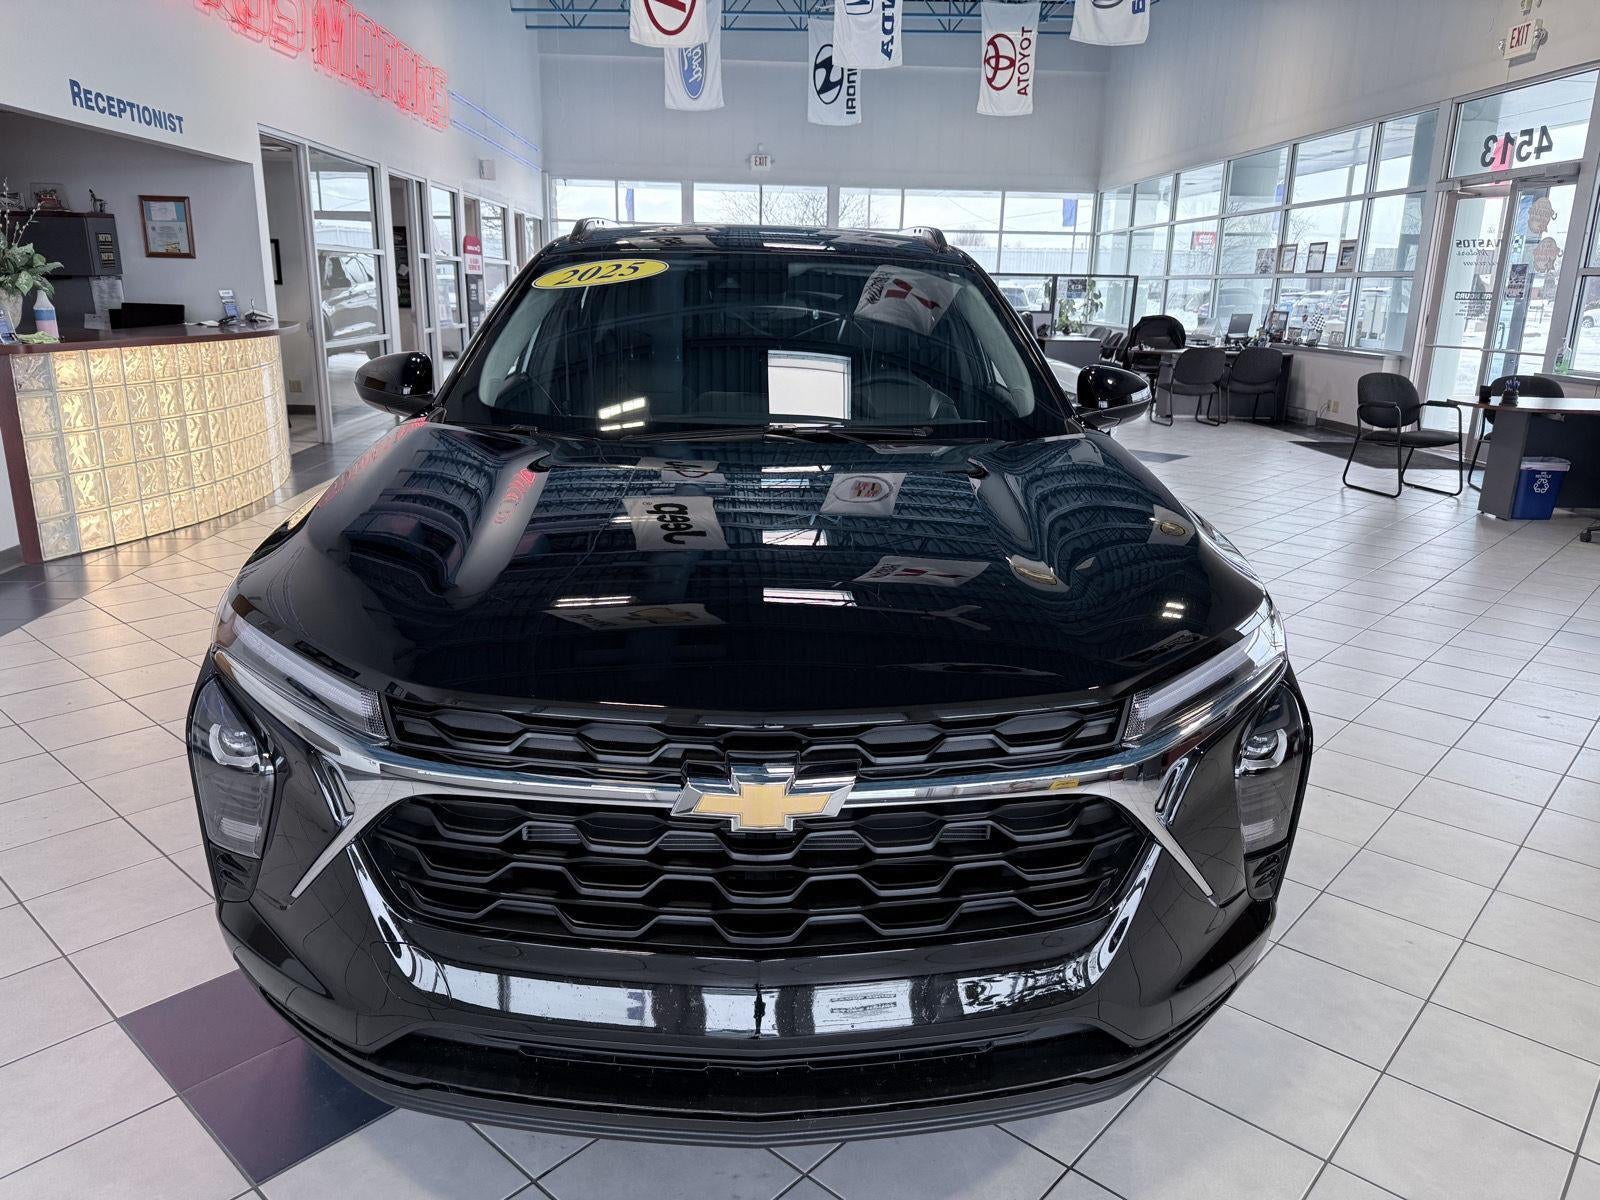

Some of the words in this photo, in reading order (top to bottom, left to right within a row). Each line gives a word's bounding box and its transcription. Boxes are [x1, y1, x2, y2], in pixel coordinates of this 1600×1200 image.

[1509, 23, 1532, 49] EXIT
[69, 78, 184, 134] RECEPTIONIST
[754, 156, 768, 166] EXIT
[553, 261, 647, 286] 2025
